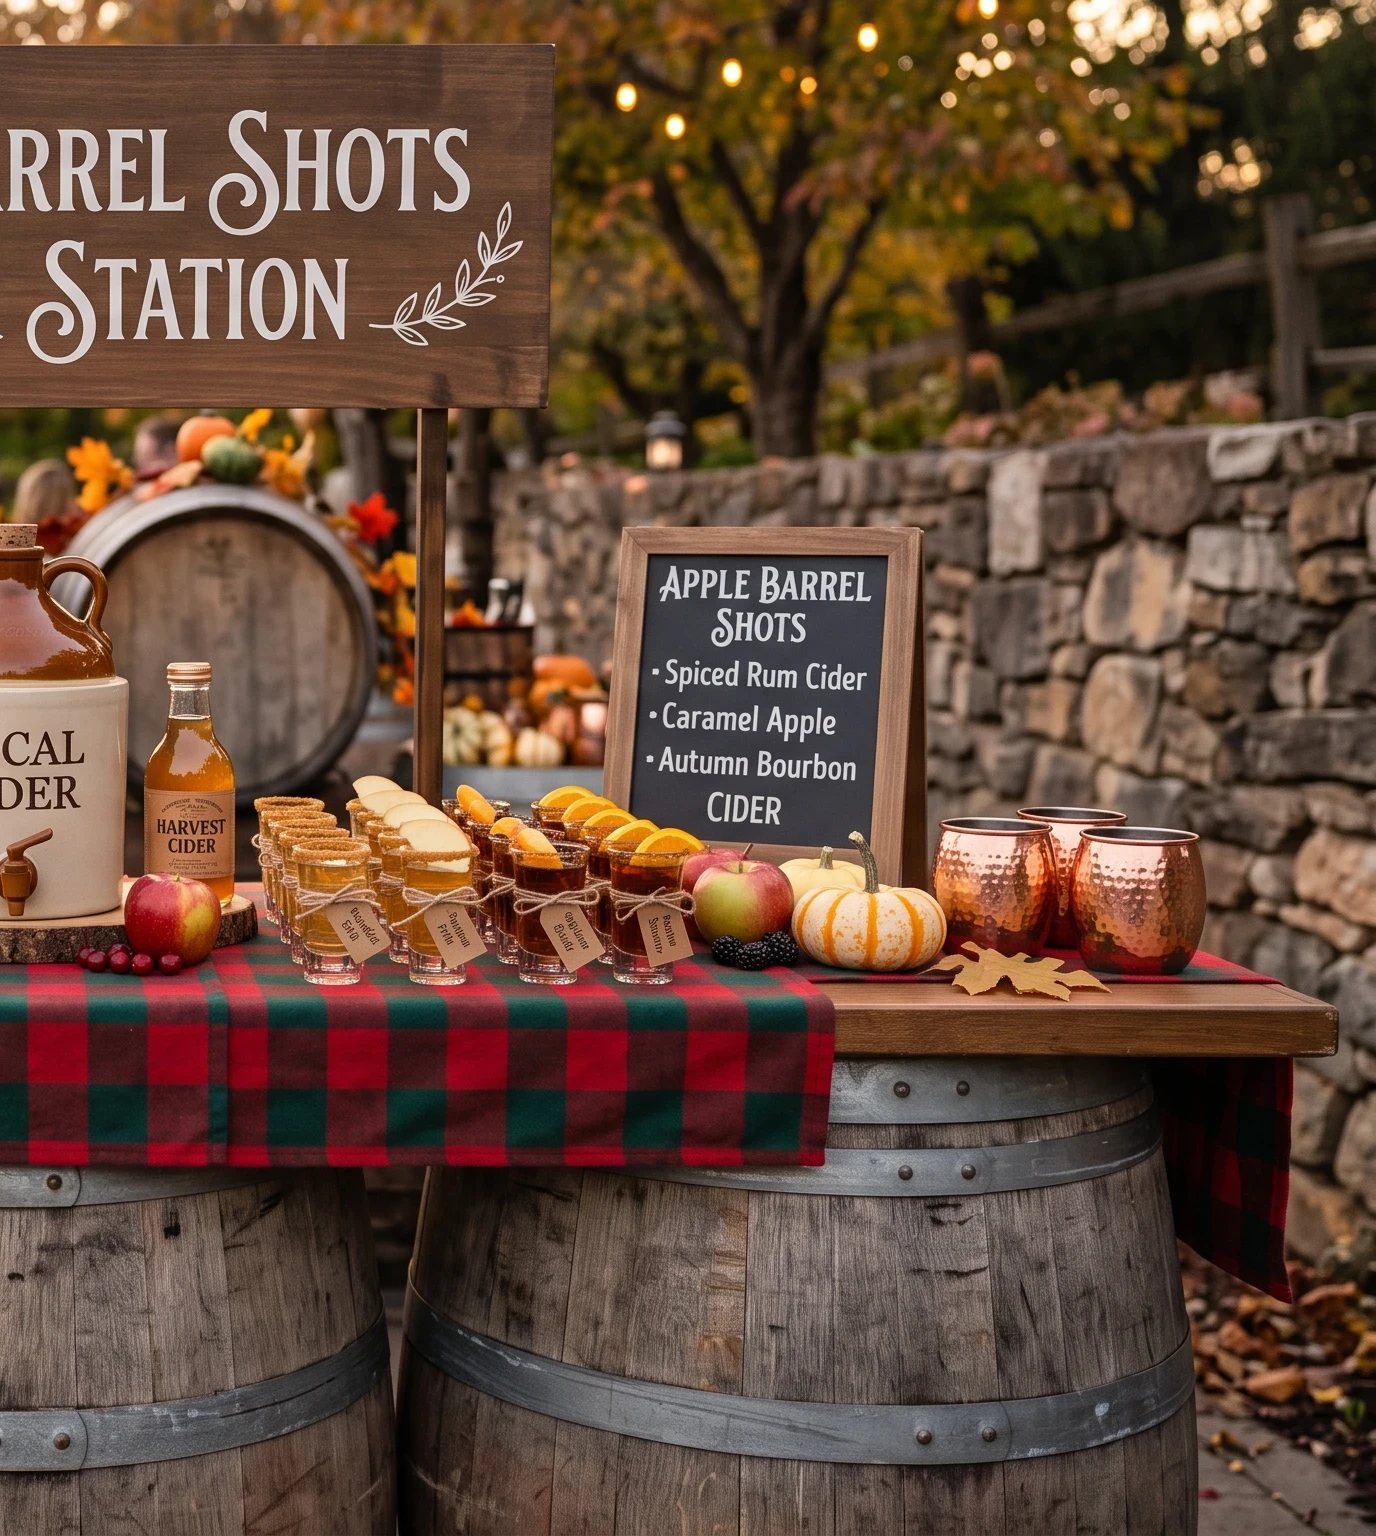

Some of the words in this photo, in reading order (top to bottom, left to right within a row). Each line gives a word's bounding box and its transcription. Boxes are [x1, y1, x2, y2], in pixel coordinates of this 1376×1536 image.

[208, 109, 472, 237] SHOTS
[26, 239, 349, 365] STATION
[660, 565, 751, 602] APPLE
[758, 566, 872, 604] BARREL
[711, 608, 807, 647] SHOTS
[665, 659, 740, 692] Spiced
[747, 662, 797, 689] Rum
[806, 663, 868, 691] Cider
[663, 702, 759, 732] Caramel
[766, 706, 837, 743] Apple
[658, 747, 749, 776] Autumn
[757, 751, 857, 781] Bourbon
[707, 792, 782, 826] CIDER
[157, 819, 226, 836] HARVEST
[167, 838, 216, 854] CIDER
